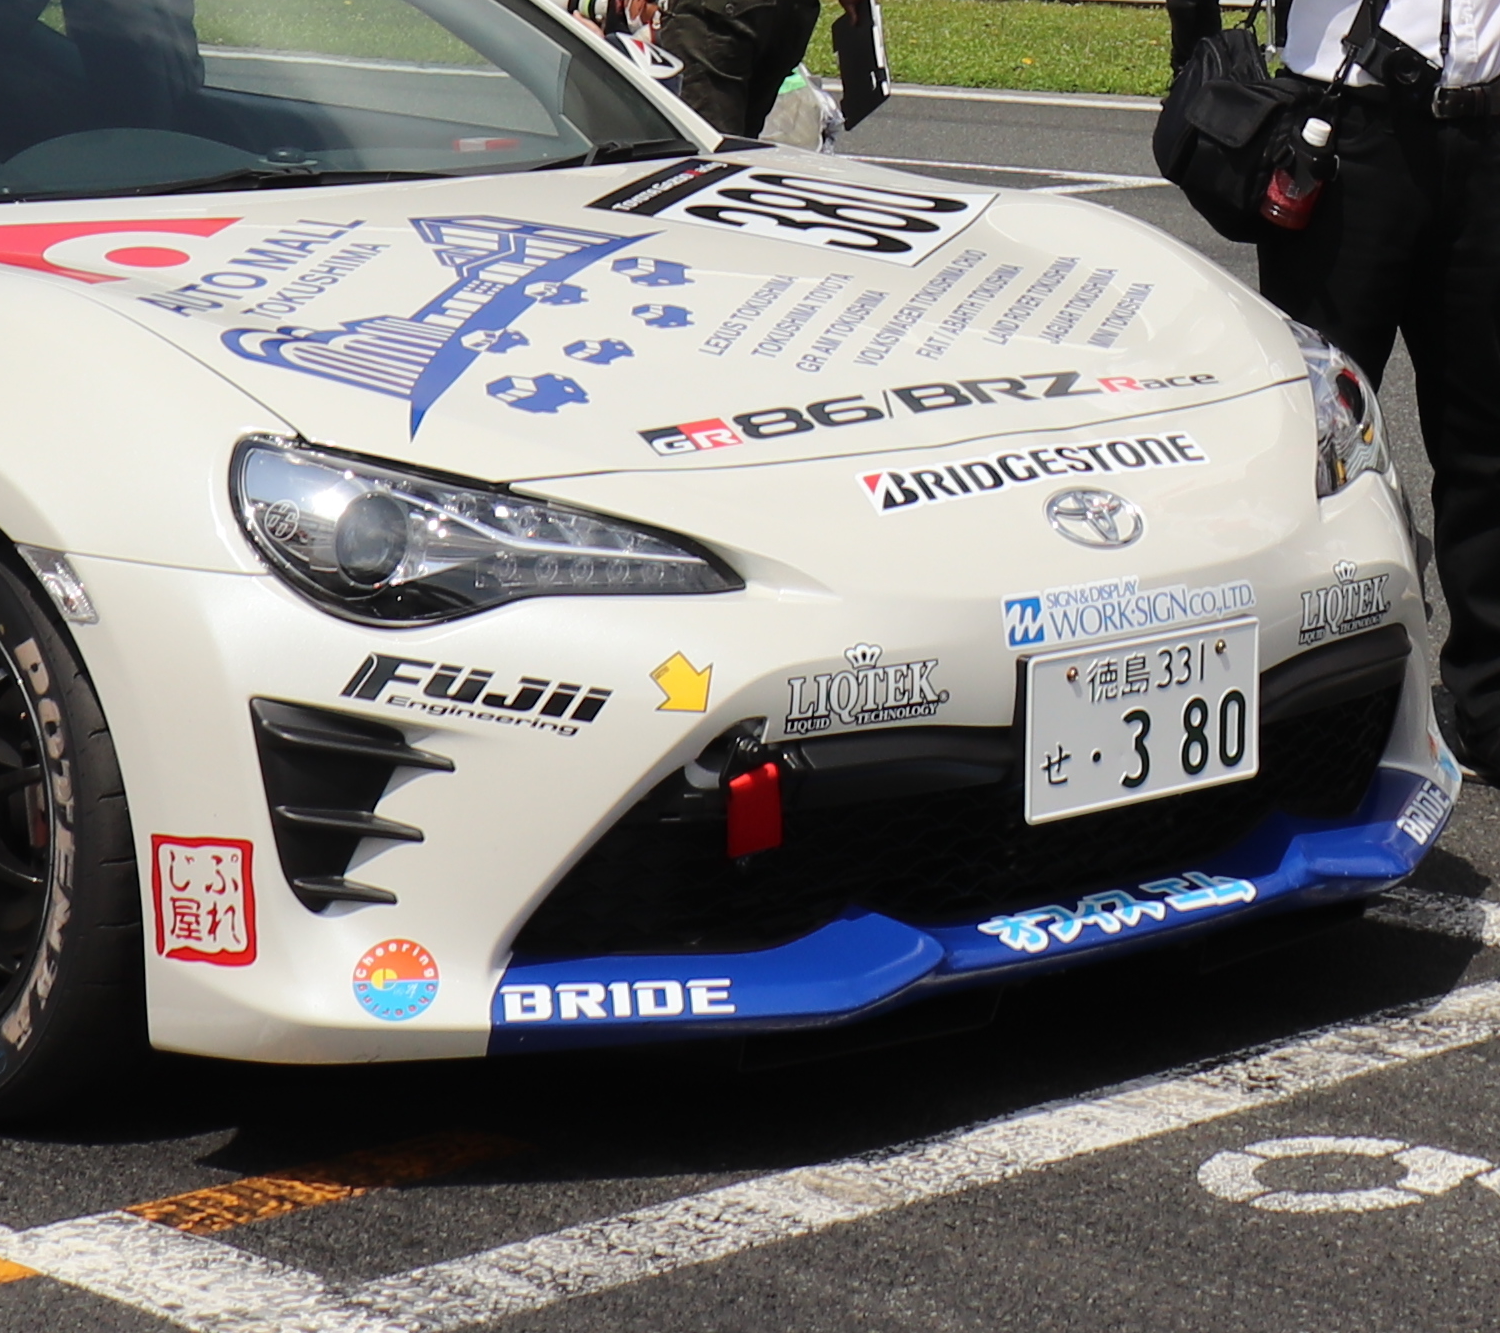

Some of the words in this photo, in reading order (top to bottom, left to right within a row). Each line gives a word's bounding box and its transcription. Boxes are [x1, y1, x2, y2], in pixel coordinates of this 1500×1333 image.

[683, 173, 968, 254] 380
[137, 270, 267, 317] AUTO
[264, 219, 367, 266] MALL
[240, 241, 391, 320] TOKUSHIMA
[698, 321, 748, 357] LEXUS
[730, 274, 799, 321] TOKUSHIMA
[751, 303, 822, 358] TOKUSHIMA
[802, 273, 855, 304] TOYOTA
[796, 353, 828, 373] GR
[824, 289, 890, 338] TOKUSHIMA
[853, 304, 927, 366] VOLKSWAGEN
[982, 319, 1020, 346] LAND
[647, 427, 743, 456] GR
[735, 370, 1103, 441] 86/BRZ
[1098, 371, 1219, 395] Race
[862, 434, 1202, 511] BRIDGESTONE
[1300, 574, 1389, 631] LIQTEK
[785, 657, 940, 727] LIQTEK
[1087, 652, 1150, 704] 徳島
[1156, 639, 1205, 689] 331
[386, 696, 579, 737] Engineering
[785, 717, 831, 734] LIQUID
[856, 702, 941, 726] TECHNOLOGY
[1040, 744, 1071, 786] せ
[1396, 780, 1450, 845] BRIDE
[500, 978, 736, 1023] BRIDE
